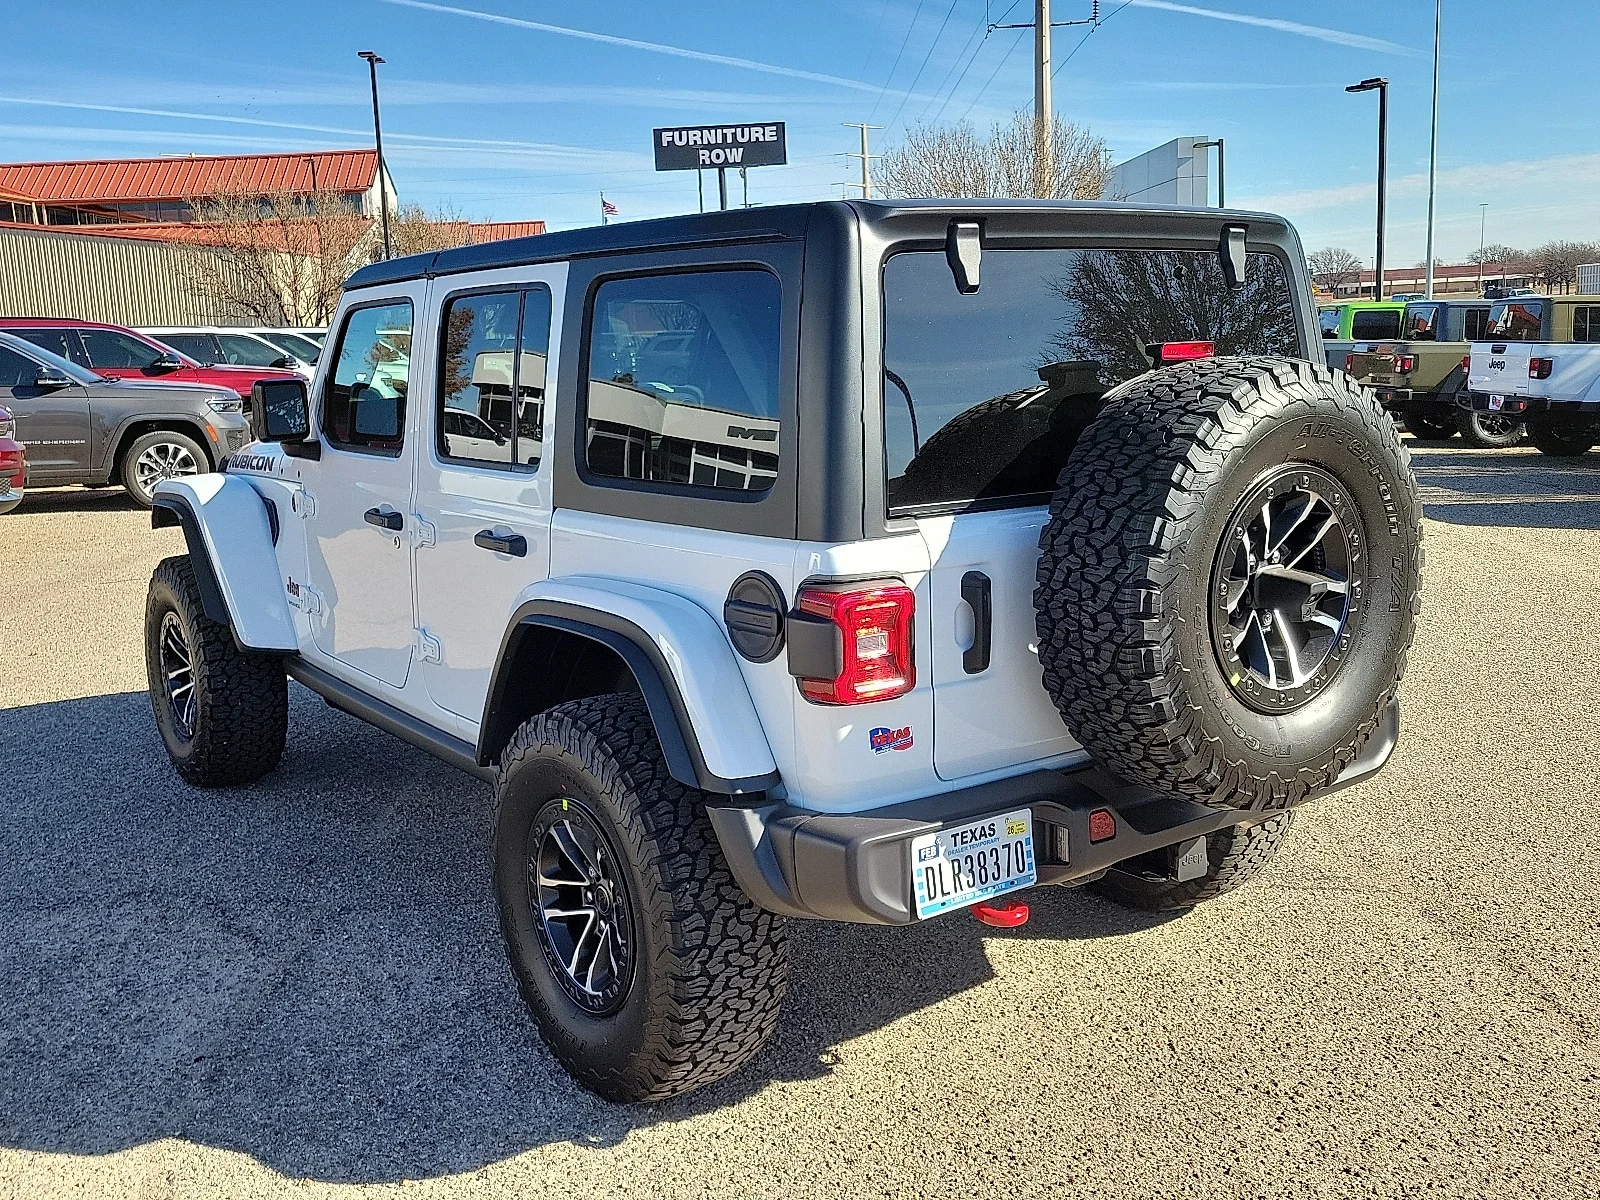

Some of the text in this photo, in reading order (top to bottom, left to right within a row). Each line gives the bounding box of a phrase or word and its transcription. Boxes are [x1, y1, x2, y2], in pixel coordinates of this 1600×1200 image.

[661, 125, 778, 147] FURNITURE
[699, 147, 744, 165] ROW
[1488, 357, 1506, 371] Jeep
[228, 454, 276, 472] RUBICON
[872, 726, 911, 748] TEXAS
[950, 822, 997, 848] TEXAS
[920, 846, 937, 860] FEB
[947, 836, 1001, 856] DEALER TEMPORARY
[1181, 852, 1204, 867] Jeep
[924, 840, 1026, 902] DLR38370
